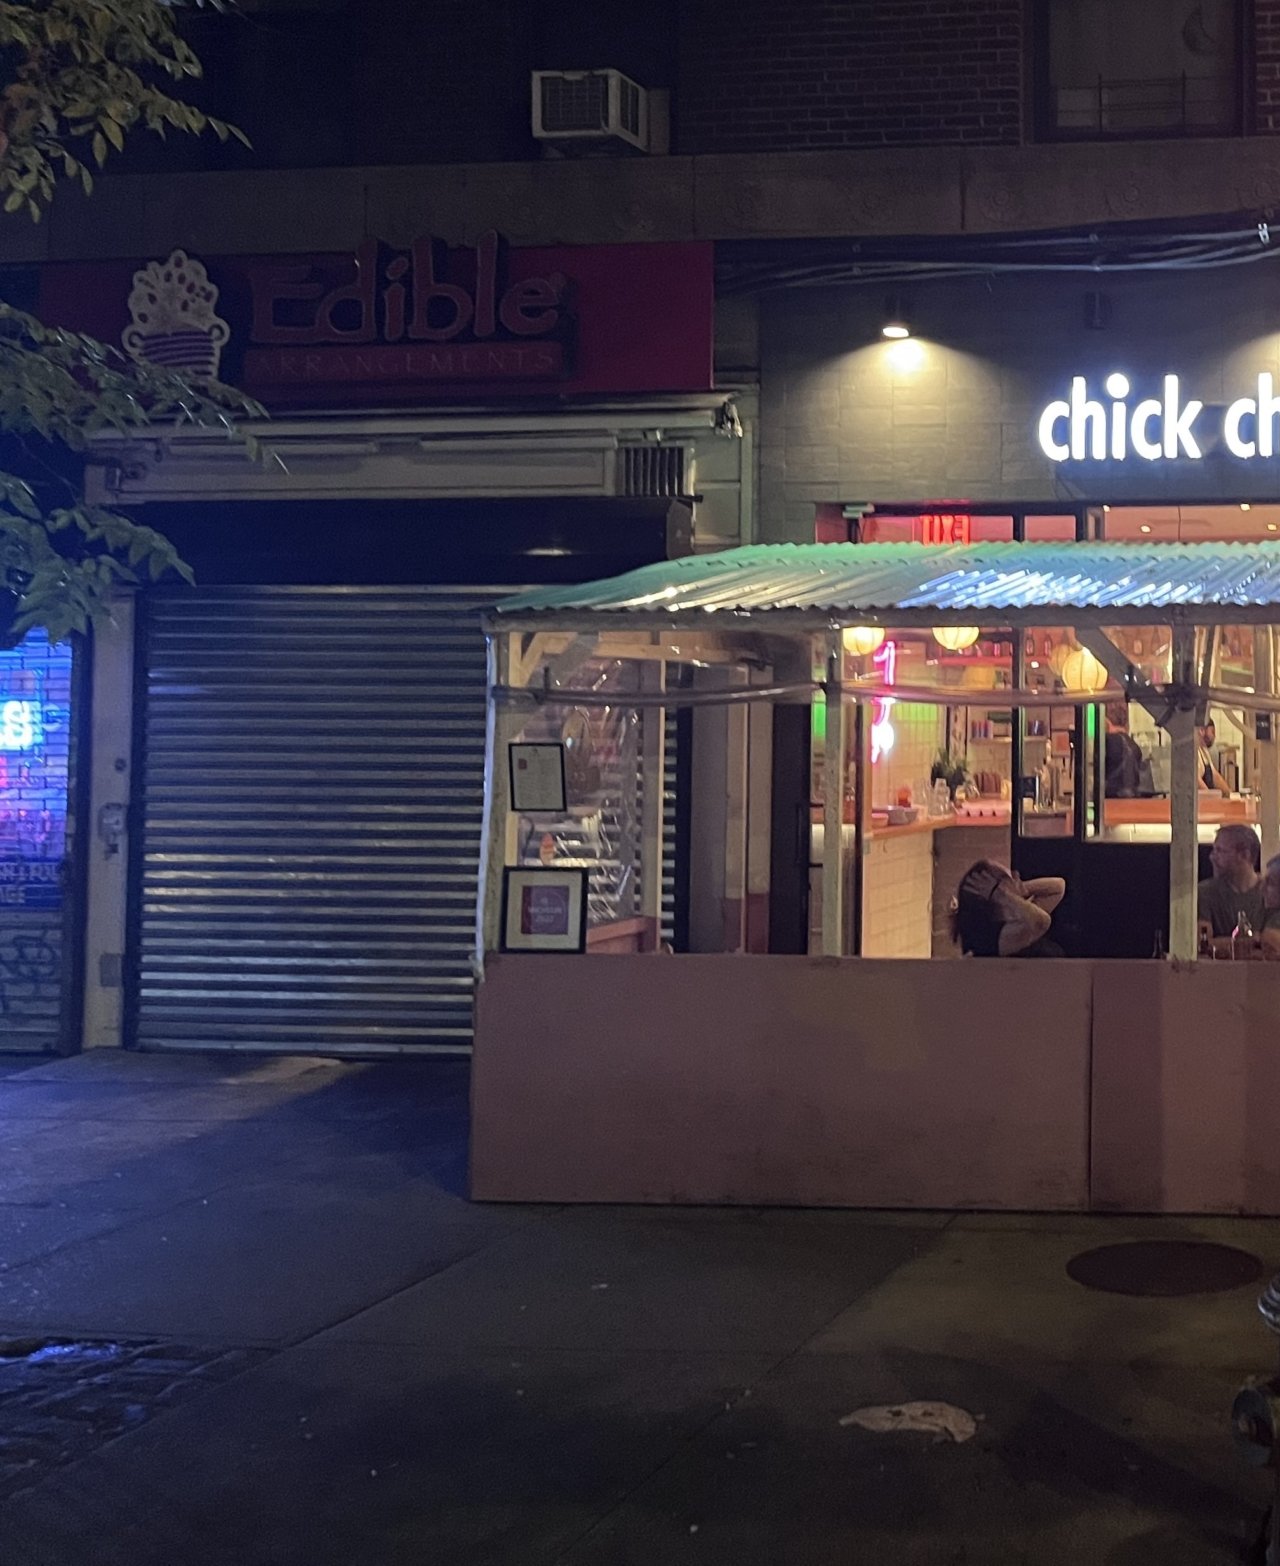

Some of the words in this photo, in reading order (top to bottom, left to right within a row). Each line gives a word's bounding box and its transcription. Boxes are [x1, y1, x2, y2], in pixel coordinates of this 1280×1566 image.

[249, 229, 559, 343] Edible
[255, 351, 554, 375] ARRANGEMENTS
[1038, 373, 1203, 461] chick
